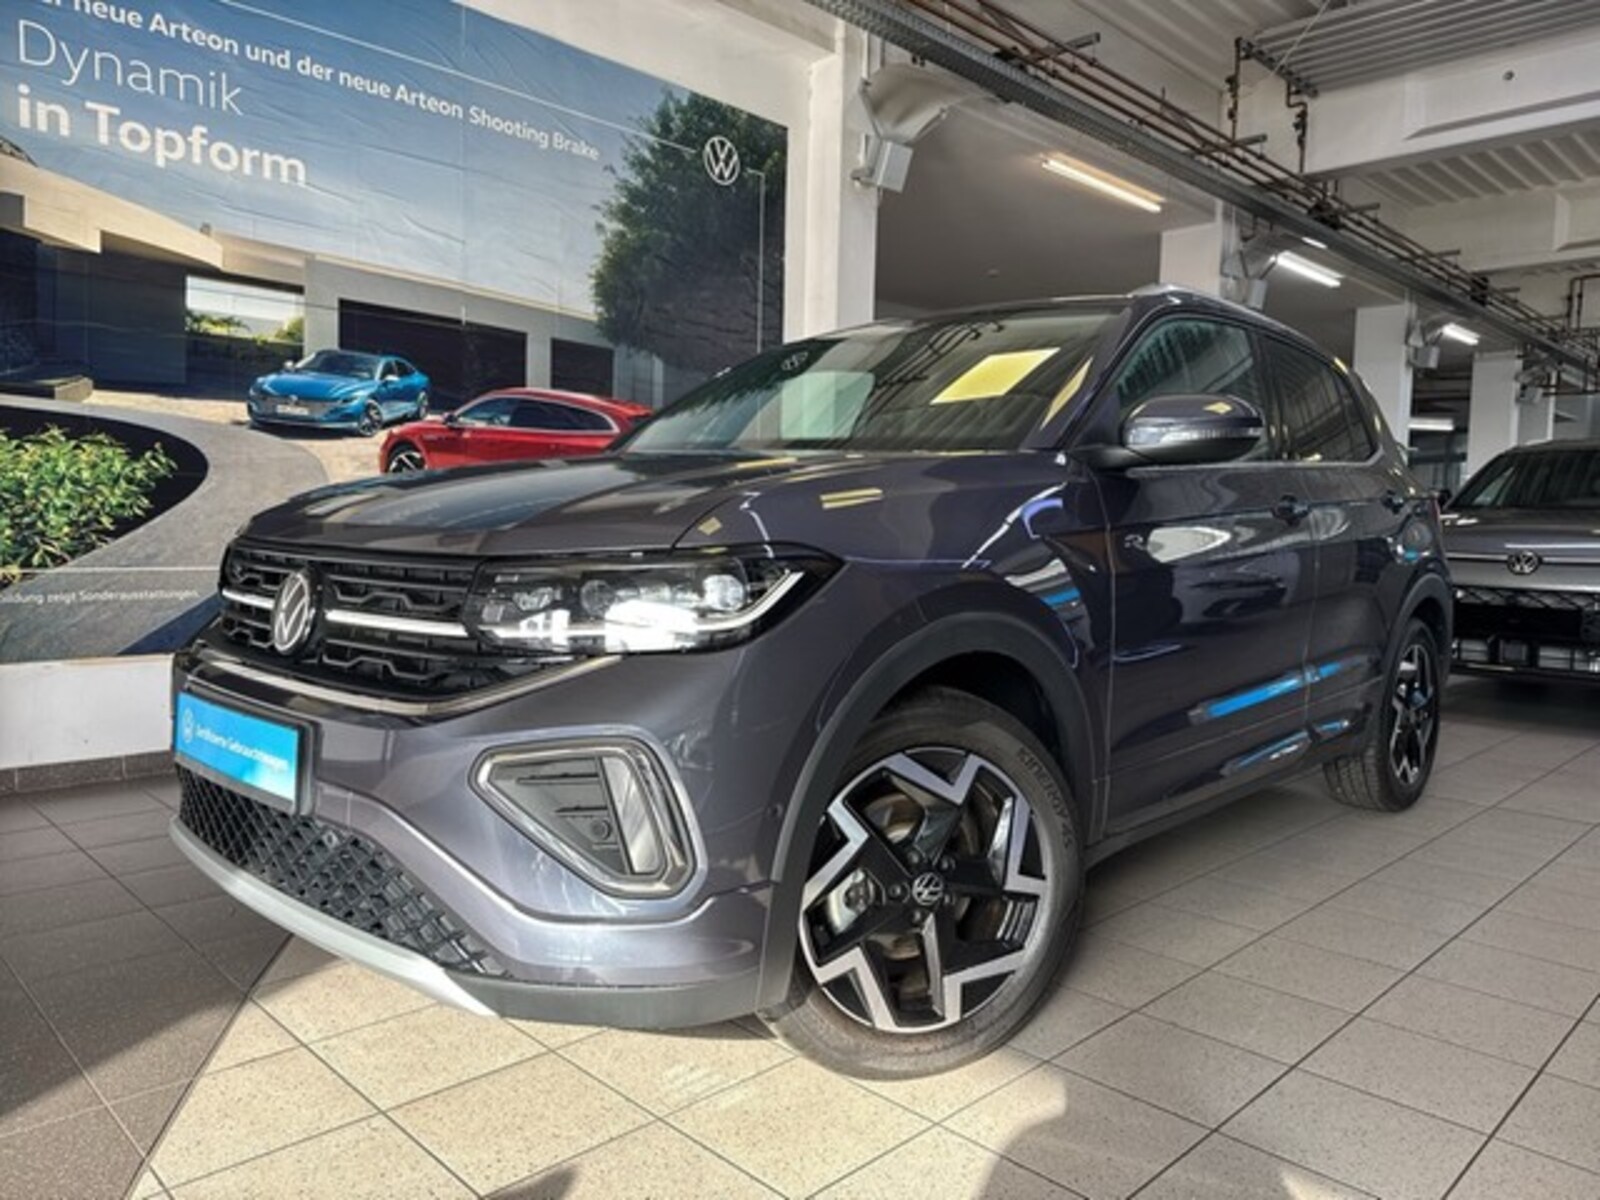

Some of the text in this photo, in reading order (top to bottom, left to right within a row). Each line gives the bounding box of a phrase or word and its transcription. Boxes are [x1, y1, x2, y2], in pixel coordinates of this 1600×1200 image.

[18, 19, 243, 116] Dynamik
[73, 0, 599, 161] neue Arteon und der neue Arteon Shooting Brake
[17, 83, 306, 186] in Topform
